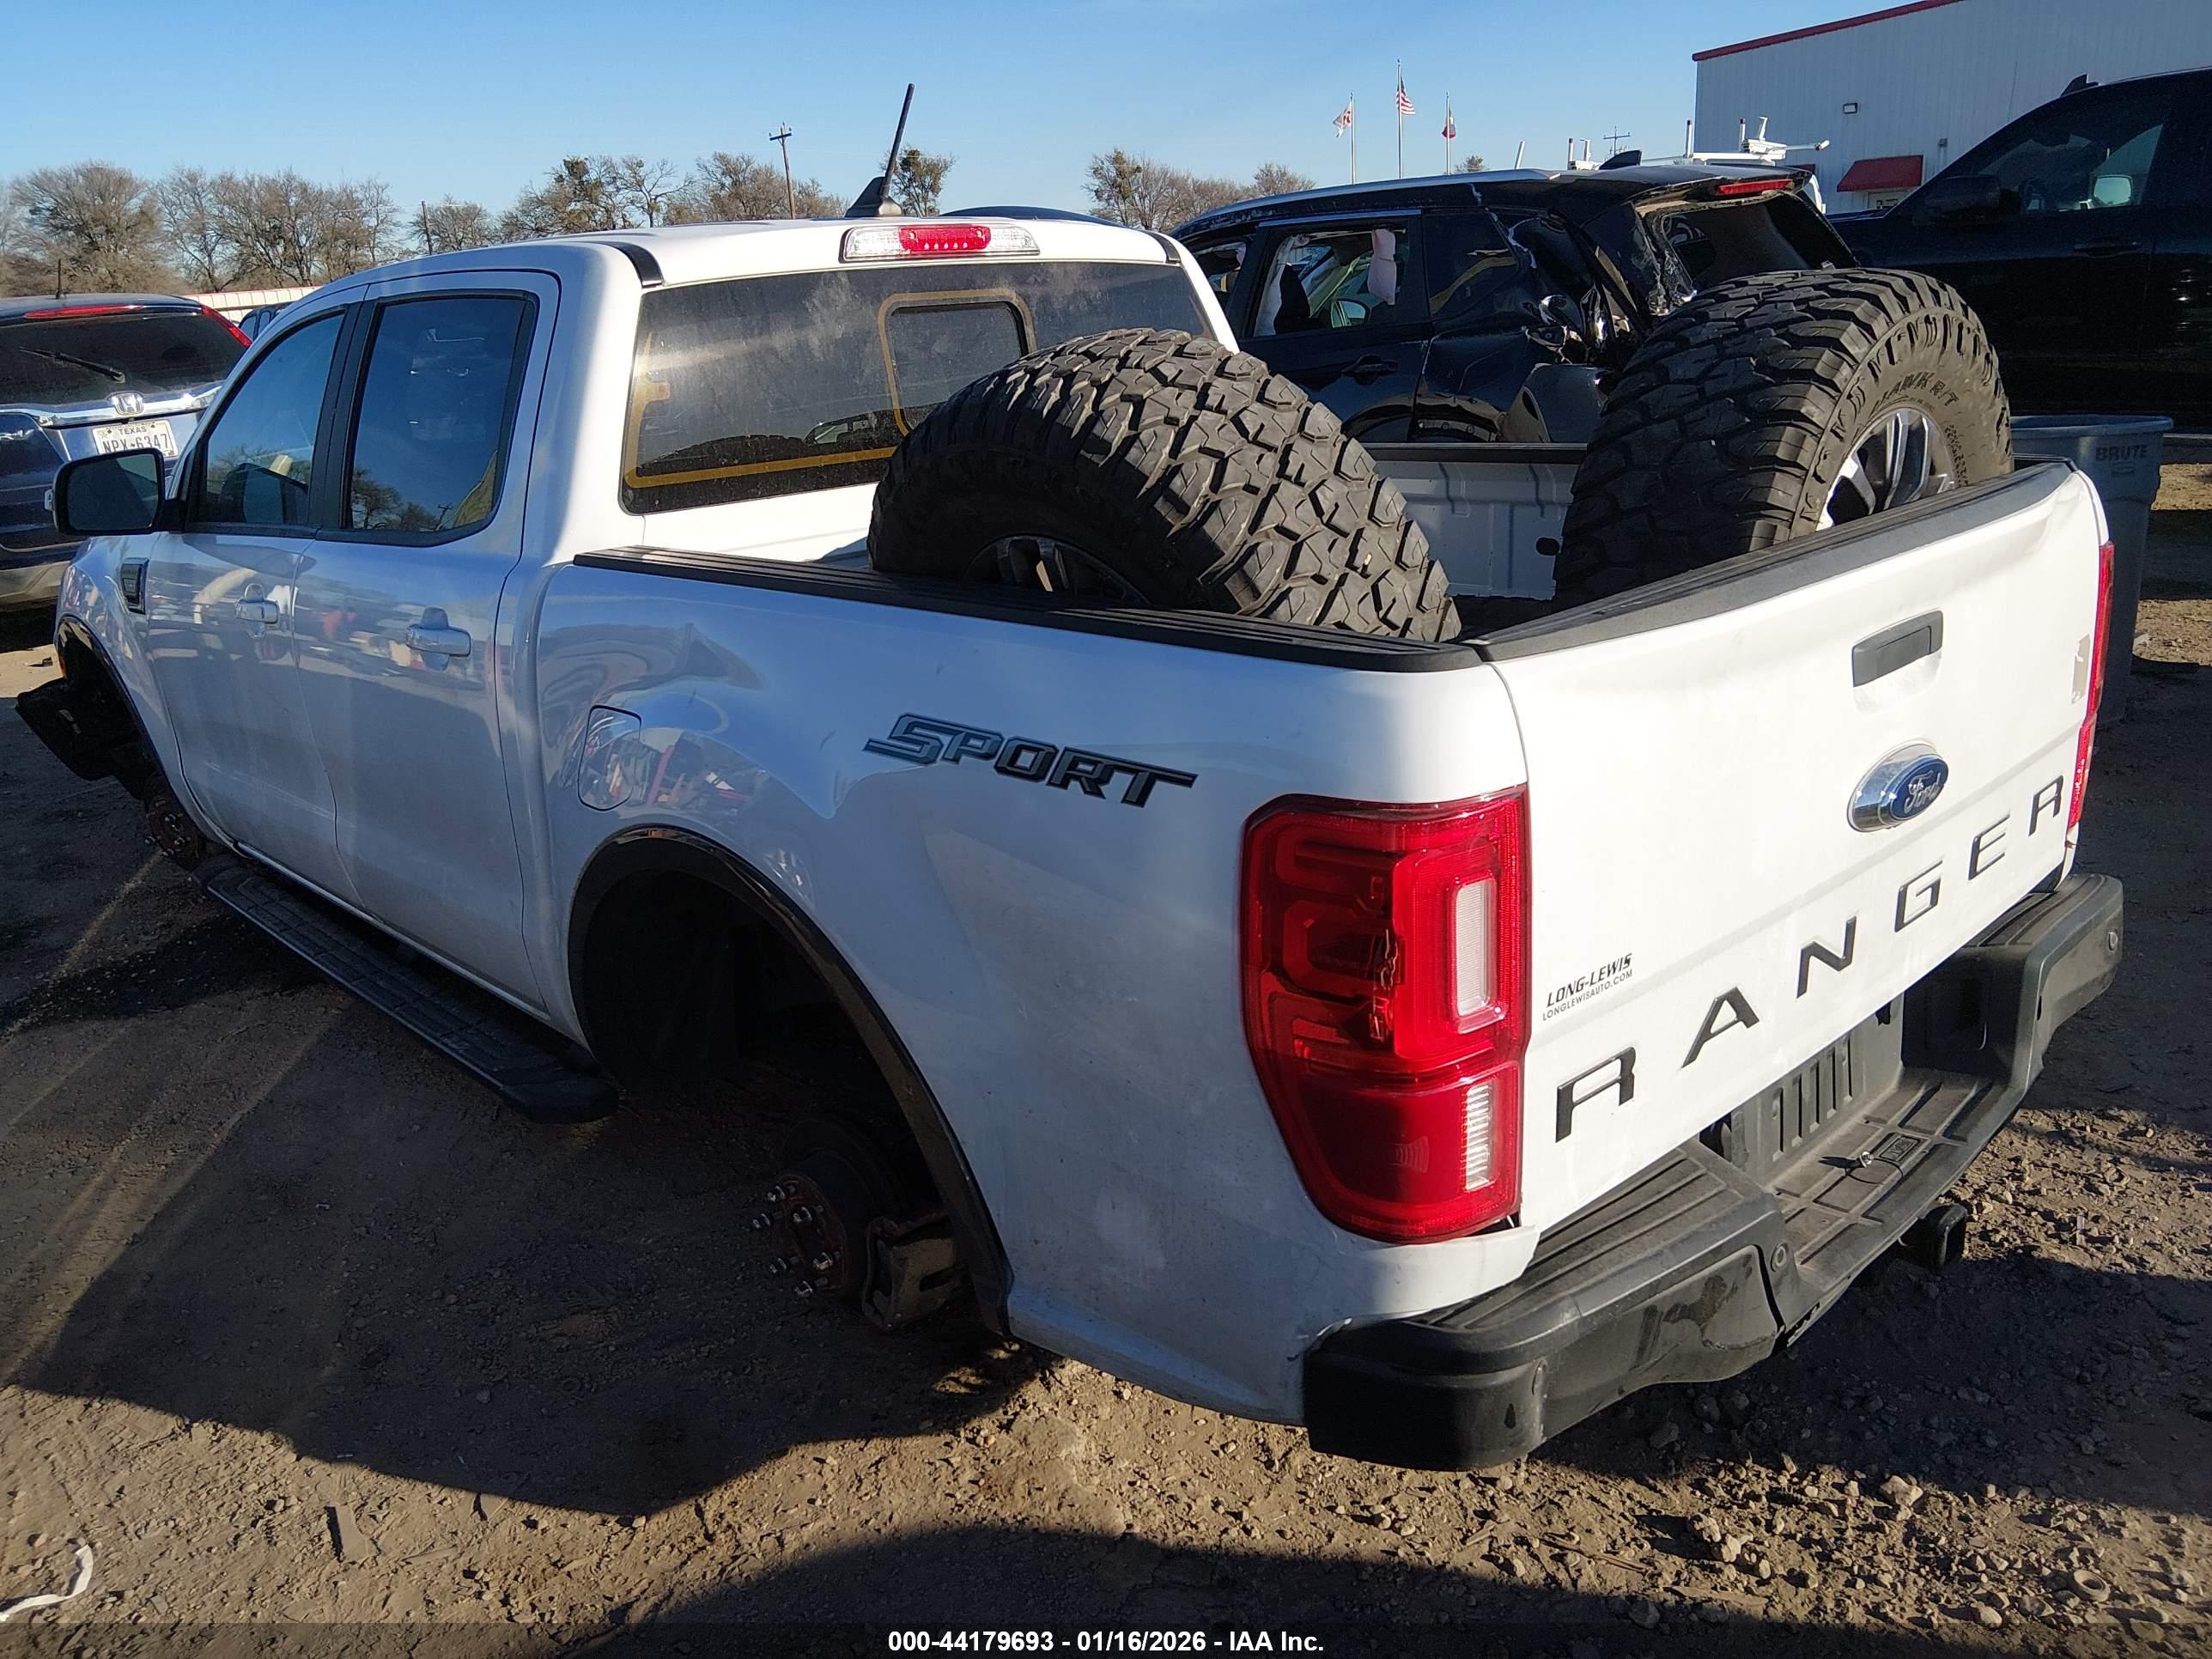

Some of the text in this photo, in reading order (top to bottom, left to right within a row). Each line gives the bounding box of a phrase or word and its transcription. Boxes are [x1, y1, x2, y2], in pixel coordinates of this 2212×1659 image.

[1929, 380, 1960, 407] R/T
[118, 426, 148, 435] TEXAS
[2095, 444, 2148, 462] BRUTE
[861, 711, 1200, 808] SPORT
[1903, 769, 1942, 814] Ford
[1547, 952, 1633, 1009] LONG-LEWIS
[1555, 775, 2064, 1144] RANGER
[1542, 969, 1633, 1022] LONGLEWISAUTO.COM
